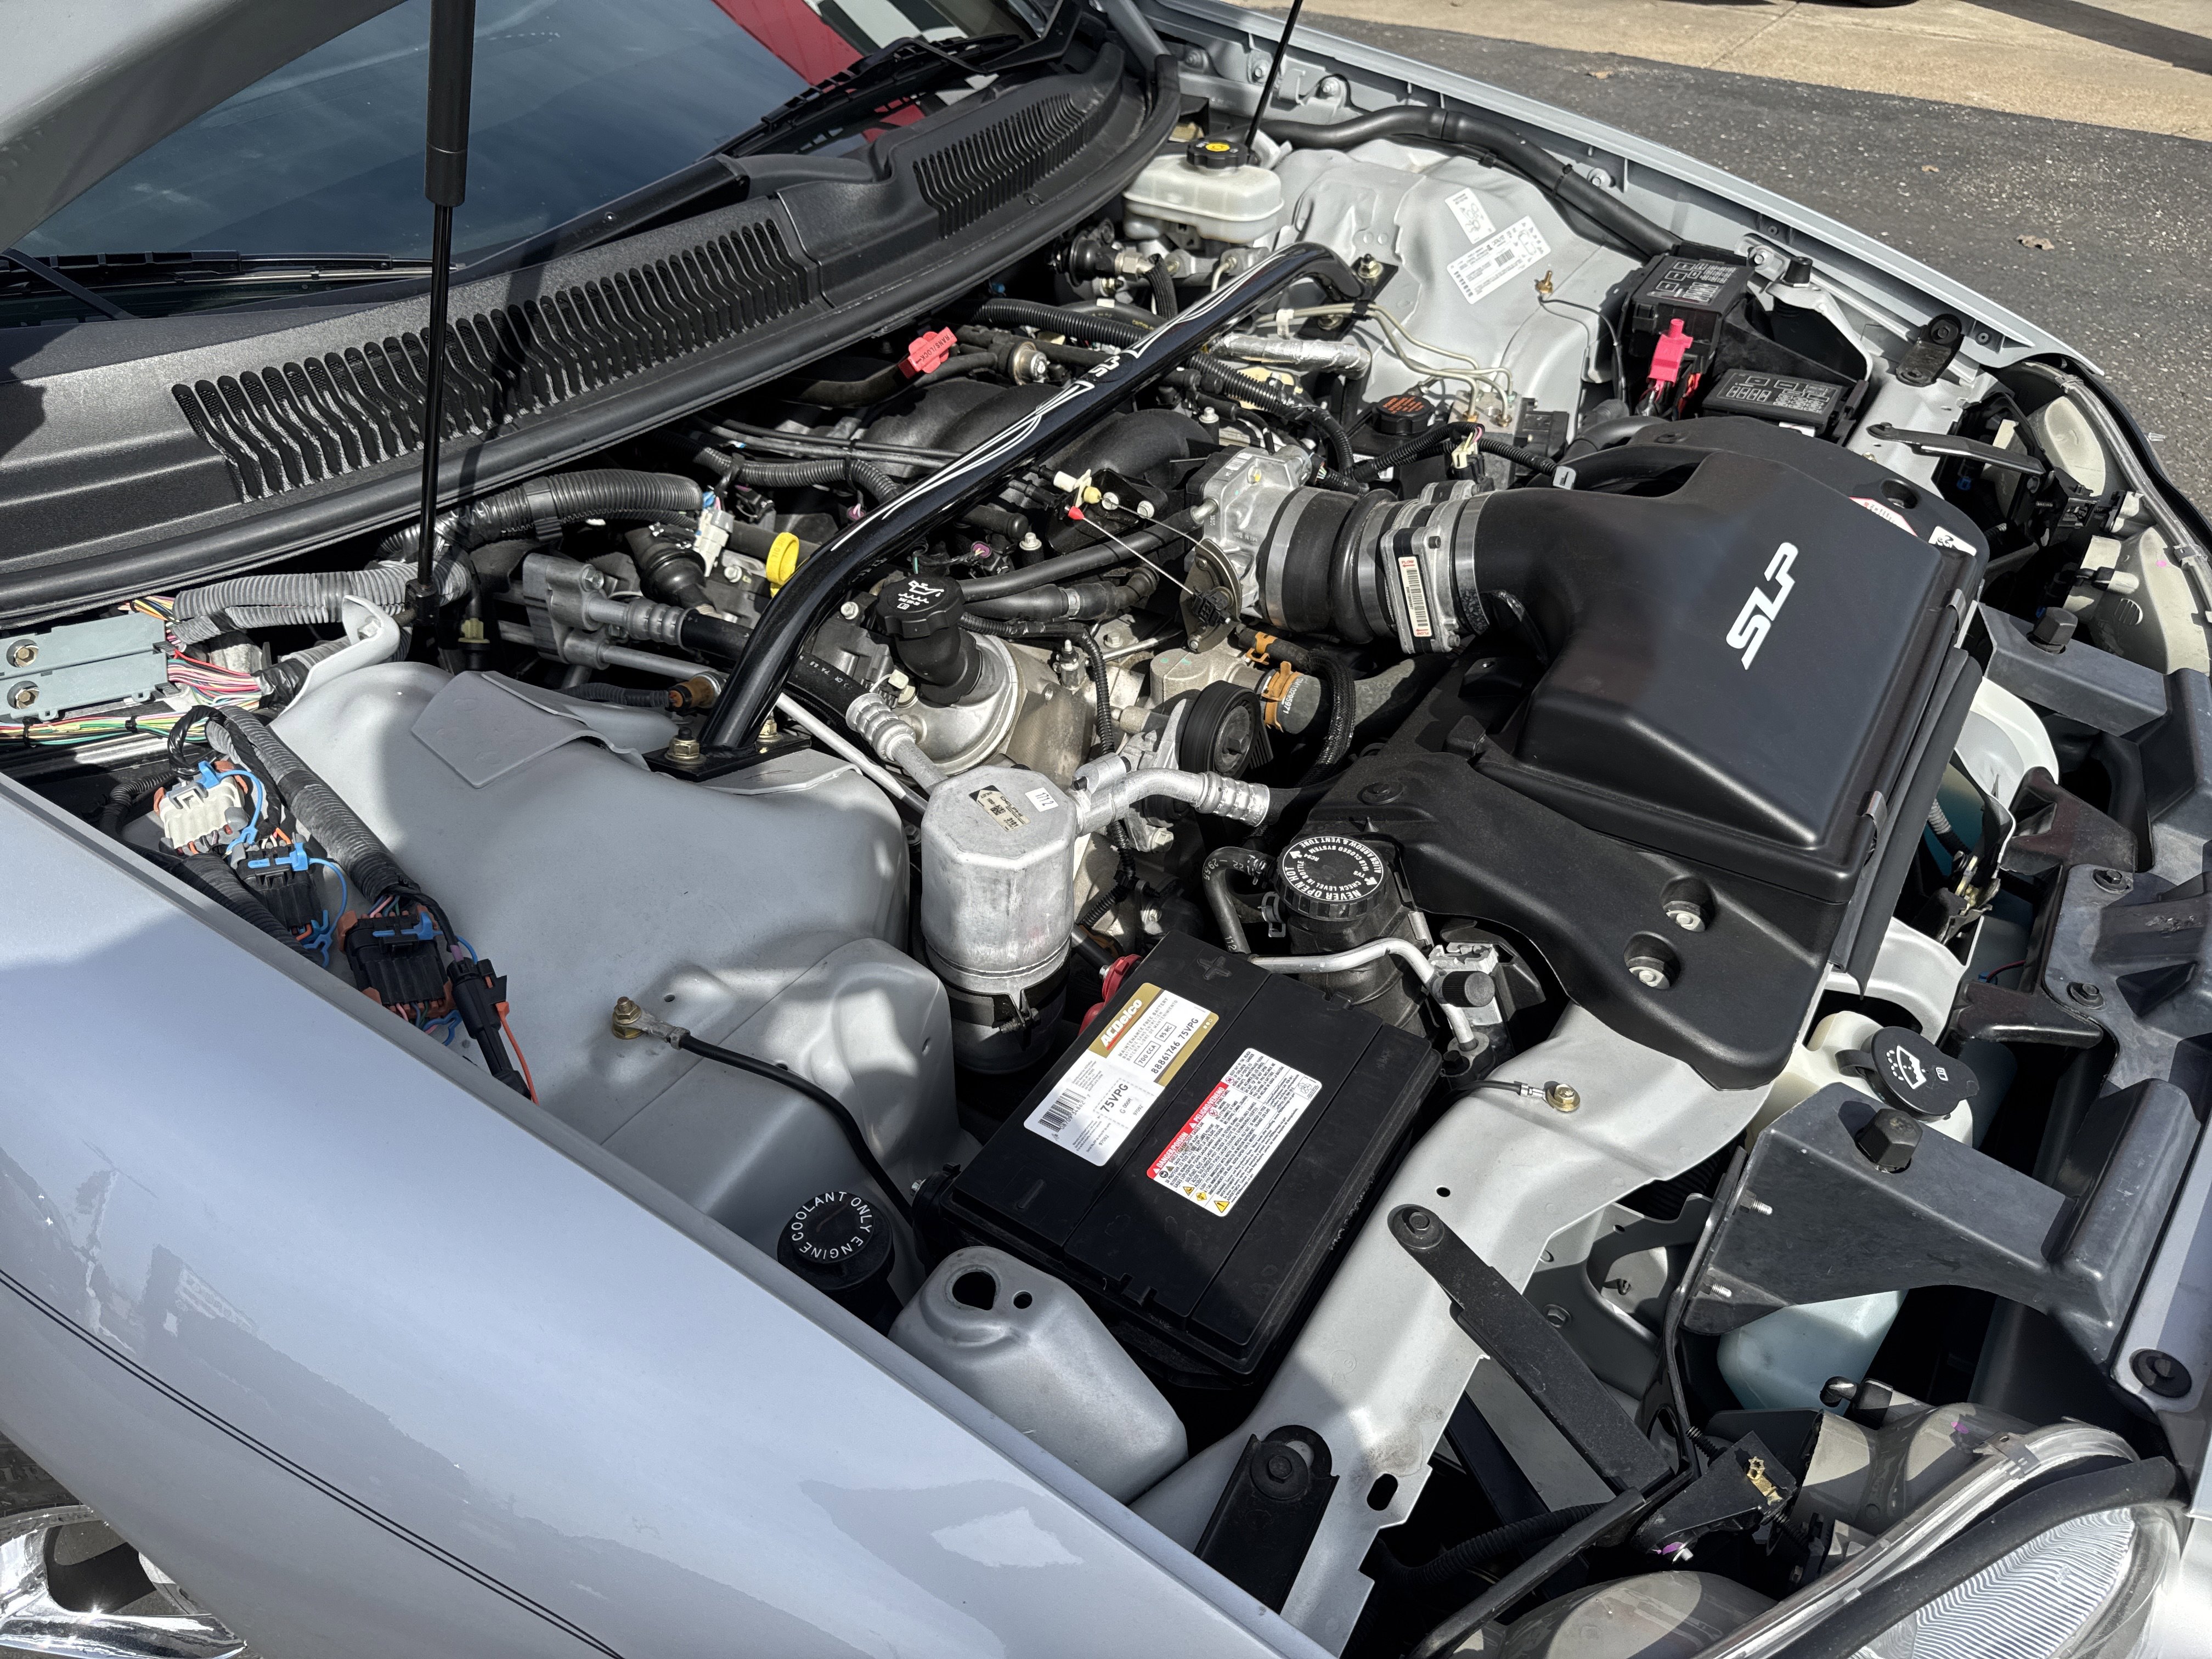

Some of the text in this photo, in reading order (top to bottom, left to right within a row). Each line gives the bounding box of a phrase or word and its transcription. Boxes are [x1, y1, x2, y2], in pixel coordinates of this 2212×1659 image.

[921, 332, 954, 362] TRANS/LOCK
[1726, 542, 1798, 670] SLP
[1282, 678, 1304, 714] GM10295971
[1000, 796, 1024, 817] DELPHI
[1298, 838, 1319, 848] TUBE
[1308, 845, 1336, 854] SYSTEM
[1338, 846, 1362, 860] CLOSED
[1348, 839, 1373, 856] ARROW
[1296, 860, 1308, 879] BOTTLE
[1369, 856, 1381, 873] ALIGN
[1284, 866, 1361, 900] NEVER OPEN HOT
[1317, 882, 1336, 891] LEVEL
[1339, 881, 1361, 891] CHECK
[1225, 935, 1237, 951] 112
[1099, 998, 1143, 1047] ACDelco
[1118, 997, 1169, 1056] MAINTENANCE FREE BATTERY
[1164, 1024, 1172, 1032] RC
[1136, 1030, 1147, 1041] SANS
[1150, 1017, 1199, 1074] 88861746 75VPG
[1138, 1044, 1156, 1064] 700 CCA
[1099, 1082, 1129, 1113] 75VPG
[1156, 1131, 1189, 1169] DANGER/POISON
[1192, 1086, 1225, 1122] PELIGRO/VENENO
[791, 1192, 873, 1259] ENGINE COOLANT ONLY
